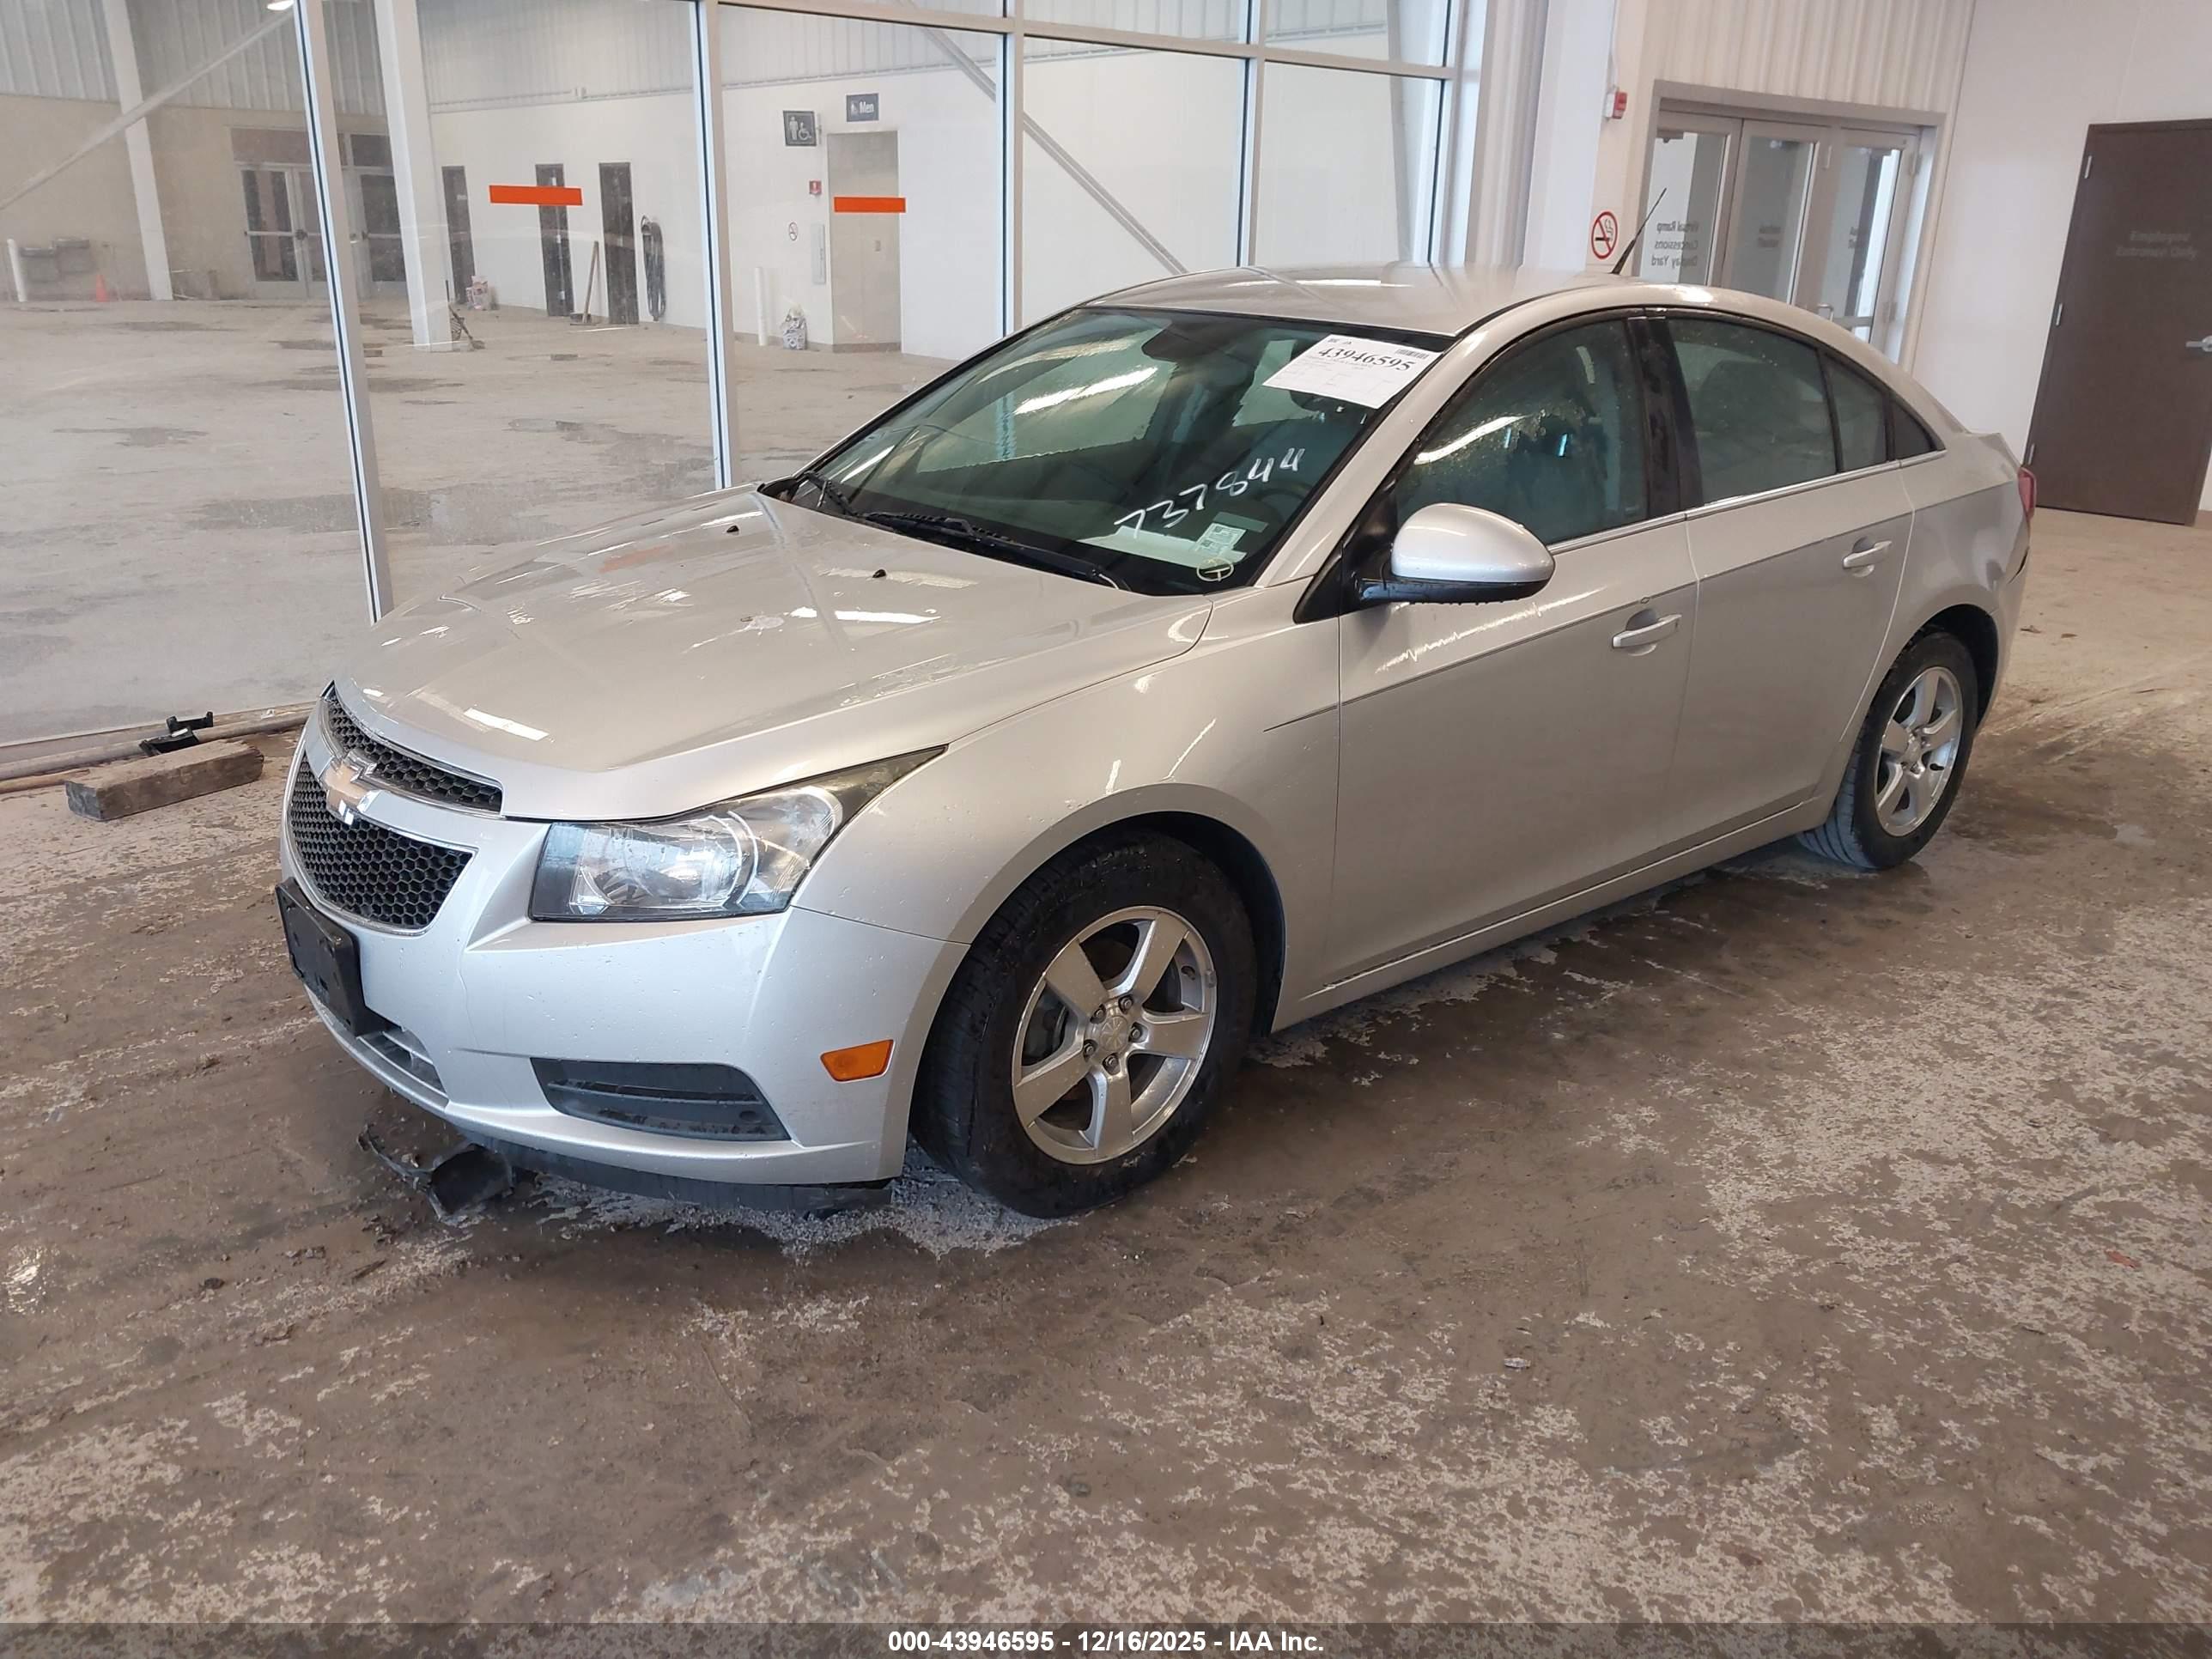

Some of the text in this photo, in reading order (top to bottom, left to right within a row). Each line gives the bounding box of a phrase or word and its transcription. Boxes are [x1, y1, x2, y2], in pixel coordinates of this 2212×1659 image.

[860, 101, 874, 114] Men
[1318, 347, 1415, 372] 43946595
[1114, 447, 1306, 539] 737844
